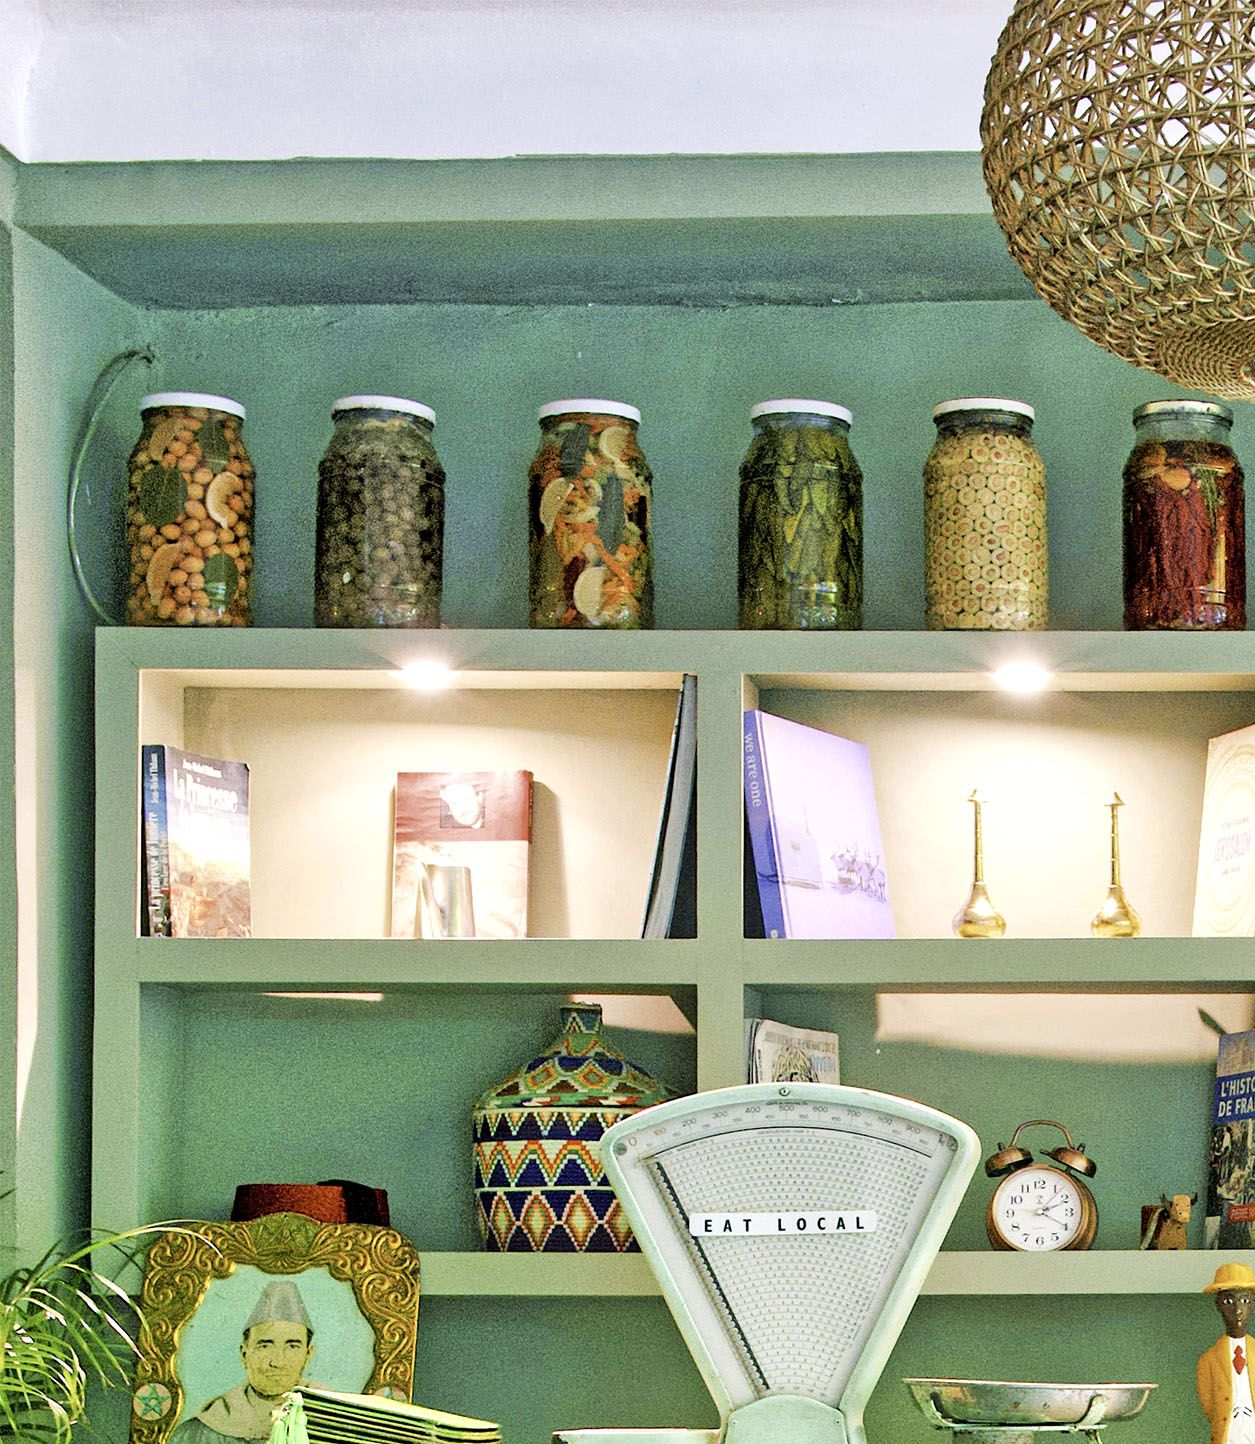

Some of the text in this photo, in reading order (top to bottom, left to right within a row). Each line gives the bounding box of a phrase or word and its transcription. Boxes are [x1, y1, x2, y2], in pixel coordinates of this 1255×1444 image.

[744, 733, 762, 807] we are one
[1218, 1100, 1233, 1117] DE
[1021, 1184, 1030, 1193] 11
[1034, 1180, 1046, 1190] 12
[1011, 1195, 1023, 1204] 10
[1006, 1209, 1015, 1218] 9
[1065, 1208, 1074, 1217] 3
[704, 1216, 865, 1233] EAT LOCAL
[1011, 1223, 1020, 1231] 8
[1022, 1233, 1030, 1242] 7
[1036, 1236, 1045, 1246] 6
[1051, 1232, 1059, 1241] 5
